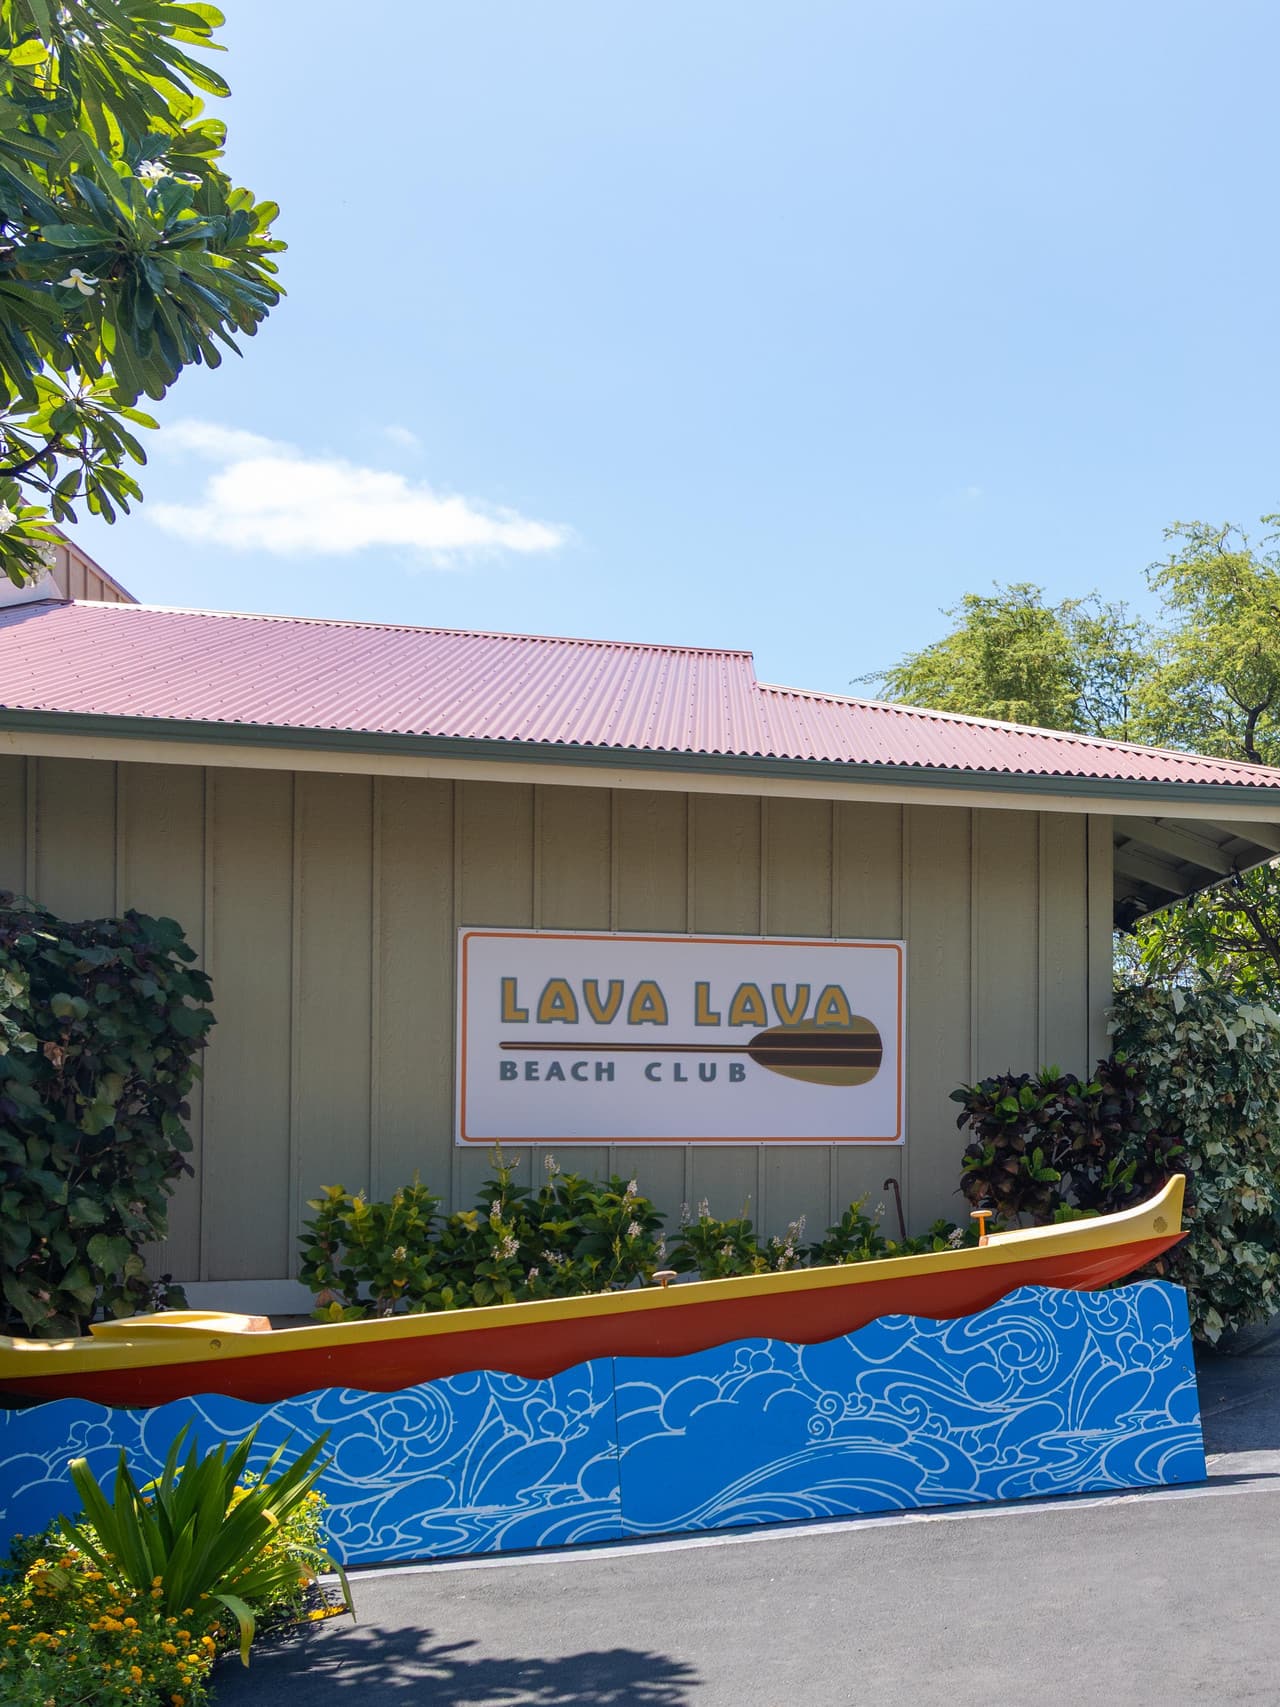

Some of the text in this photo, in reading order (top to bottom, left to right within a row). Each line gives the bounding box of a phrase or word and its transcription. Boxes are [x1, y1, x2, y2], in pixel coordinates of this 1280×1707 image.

[500, 976, 854, 1028] LAVA LAVA
[499, 1060, 747, 1083] BEACH CLUB
